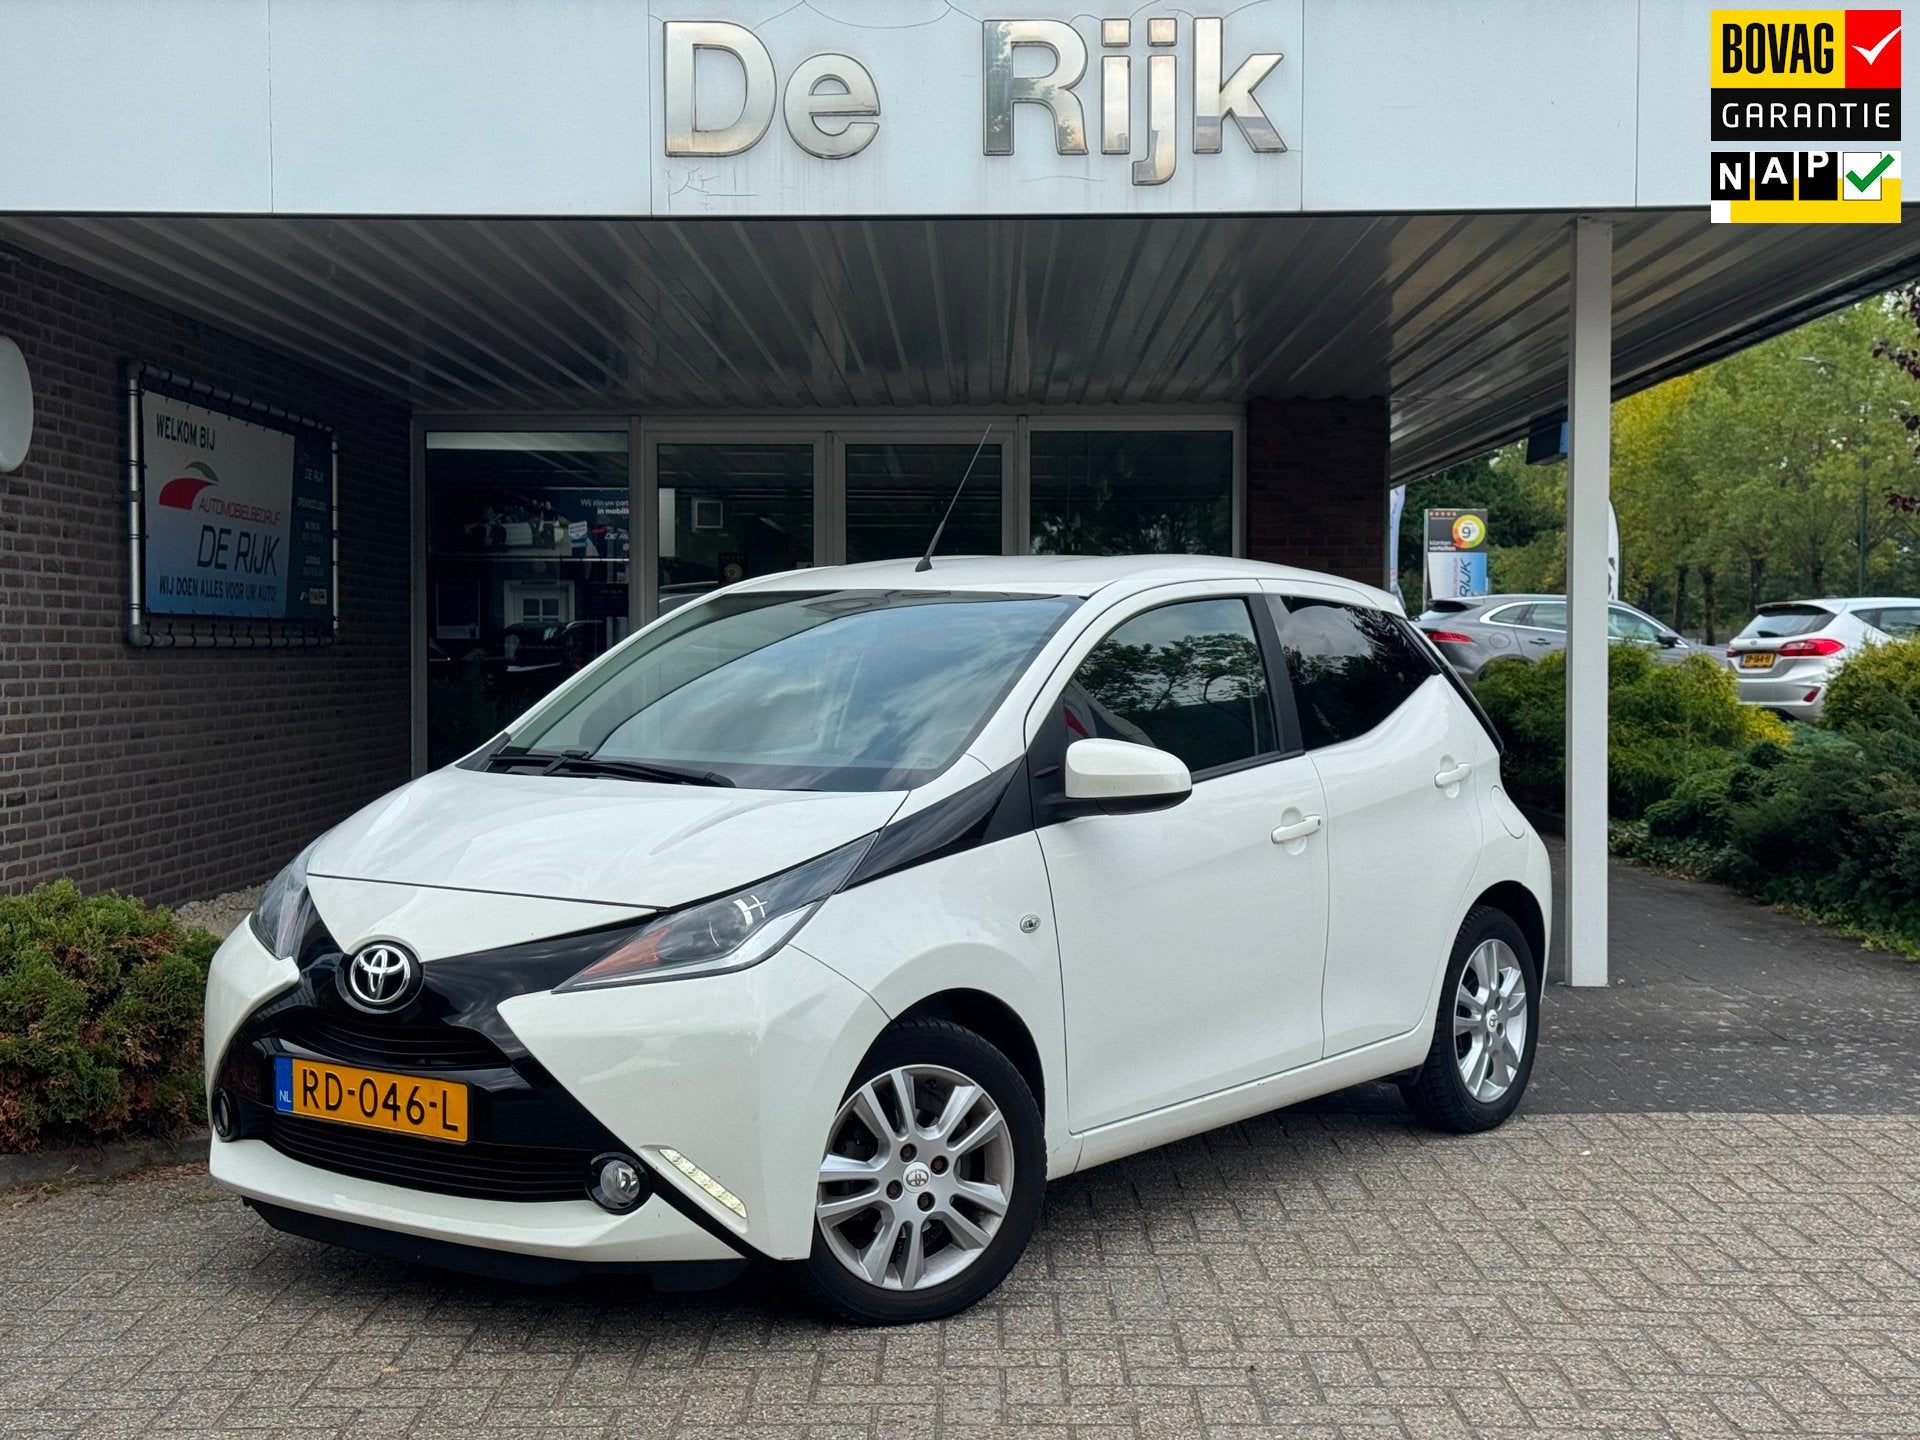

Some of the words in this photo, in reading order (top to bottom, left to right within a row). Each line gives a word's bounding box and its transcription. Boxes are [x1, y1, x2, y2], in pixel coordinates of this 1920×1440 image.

[663, 20, 881, 160] De
[982, 17, 1288, 186] Rijk
[156, 413, 197, 446] WELKOM
[199, 426, 216, 451] BIJ
[197, 525, 232, 570] DE
[234, 531, 280, 576] RIJK
[159, 575, 175, 597] WIJ
[176, 576, 197, 597] DOEN
[200, 578, 224, 599] ALLES
[224, 581, 244, 601] VOOR
[245, 583, 256, 601] UW
[279, 1089, 292, 1103] NL
[302, 1068, 459, 1132] RD-046-L
